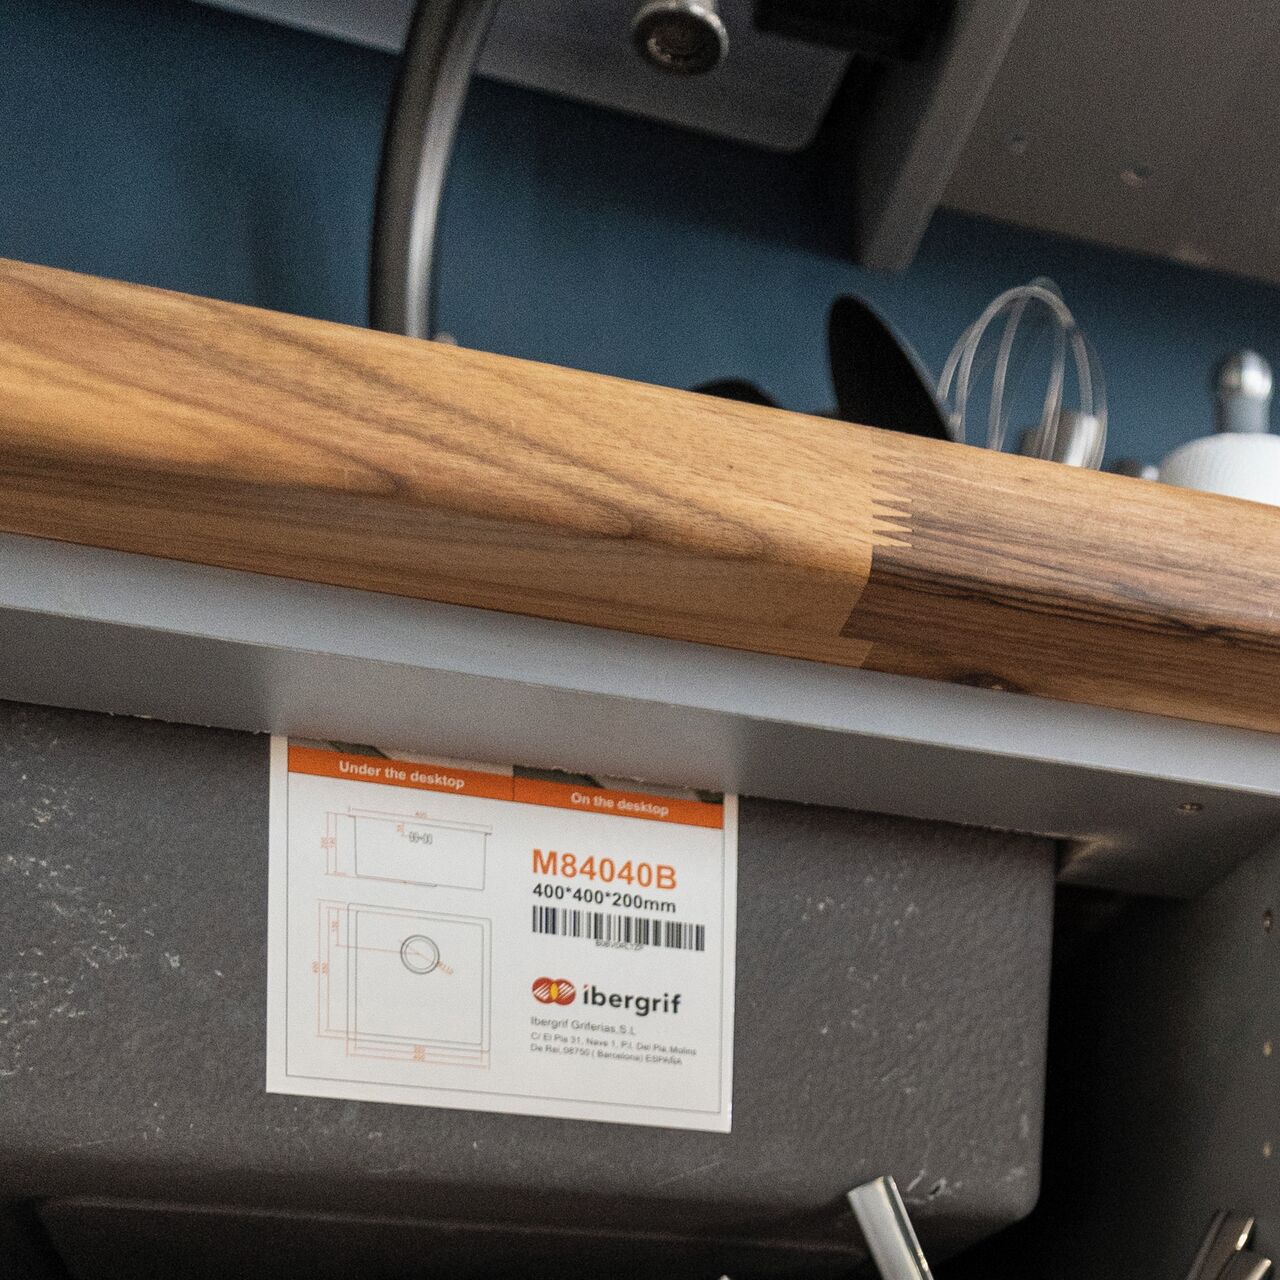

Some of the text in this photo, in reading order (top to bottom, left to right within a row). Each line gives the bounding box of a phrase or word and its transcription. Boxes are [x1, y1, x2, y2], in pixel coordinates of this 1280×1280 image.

[339, 760, 465, 790] Under the desktop
[571, 792, 669, 817] On the desktop
[532, 848, 677, 890] M84040B
[583, 984, 681, 1017] ibergrif
